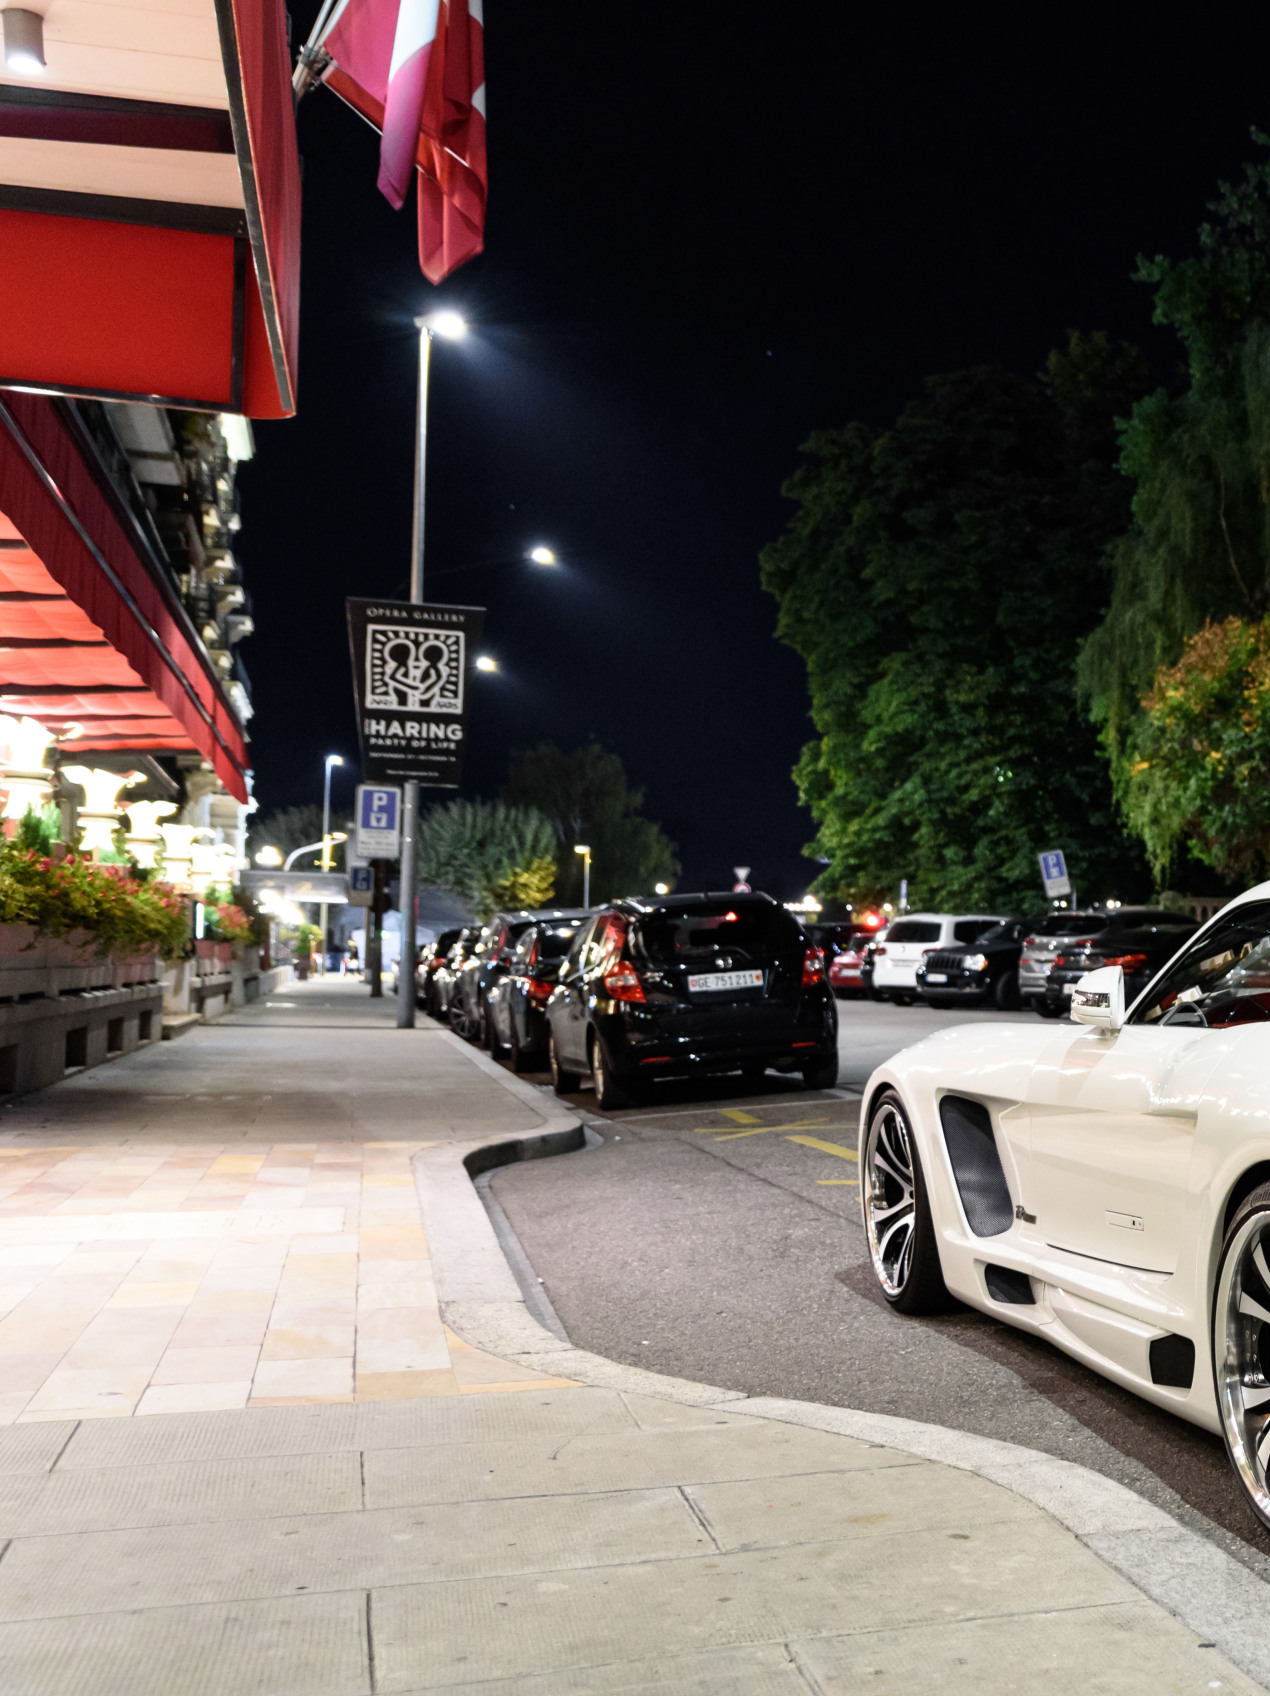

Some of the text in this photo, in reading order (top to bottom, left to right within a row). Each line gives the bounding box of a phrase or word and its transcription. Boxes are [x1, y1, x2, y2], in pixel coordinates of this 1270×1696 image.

[366, 607, 465, 622] OPERA GALLERY
[370, 719, 463, 740] HARING
[369, 737, 456, 750] PARTY OF LIFE
[373, 792, 388, 812] P
